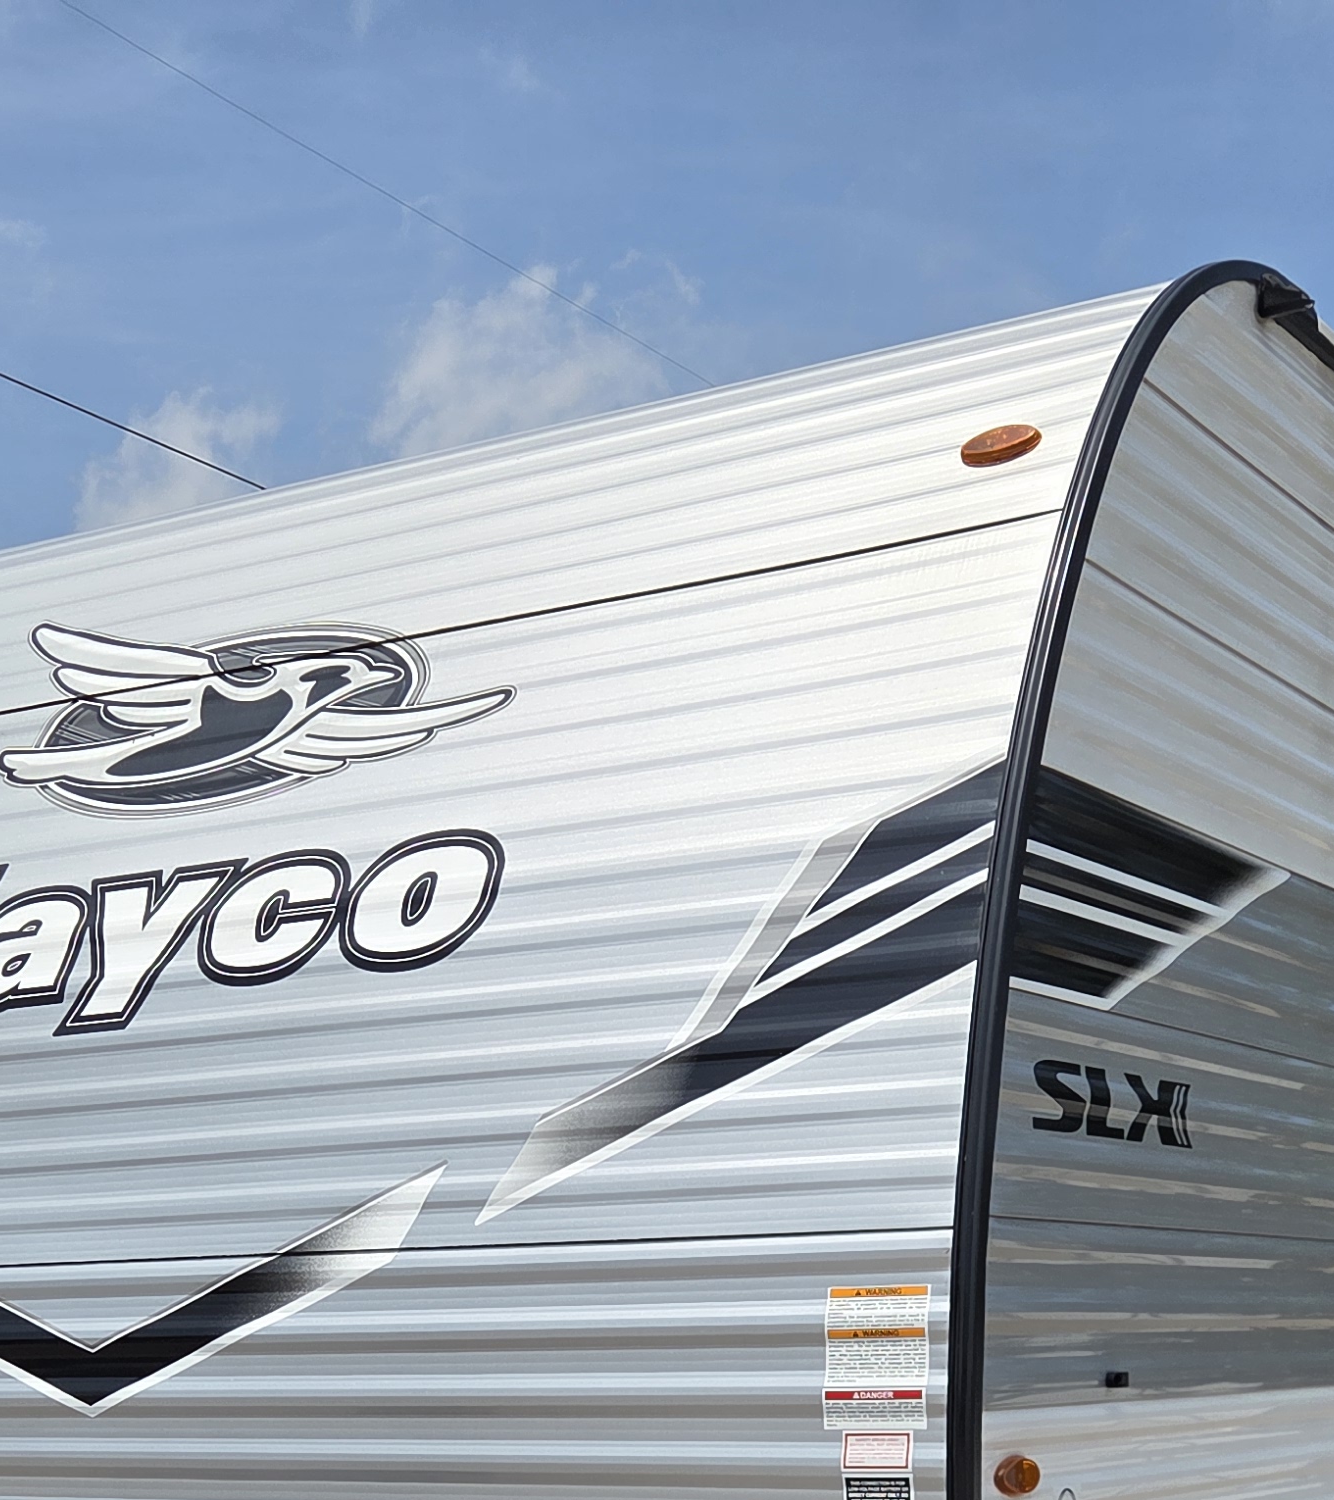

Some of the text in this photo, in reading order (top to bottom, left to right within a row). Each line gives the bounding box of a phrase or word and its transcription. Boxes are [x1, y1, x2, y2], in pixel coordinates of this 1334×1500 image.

[1032, 1059, 1193, 1149] SLX
[865, 1287, 902, 1296] WARNING
[861, 1329, 900, 1337] WARNING
[859, 1391, 894, 1399] DANGER
